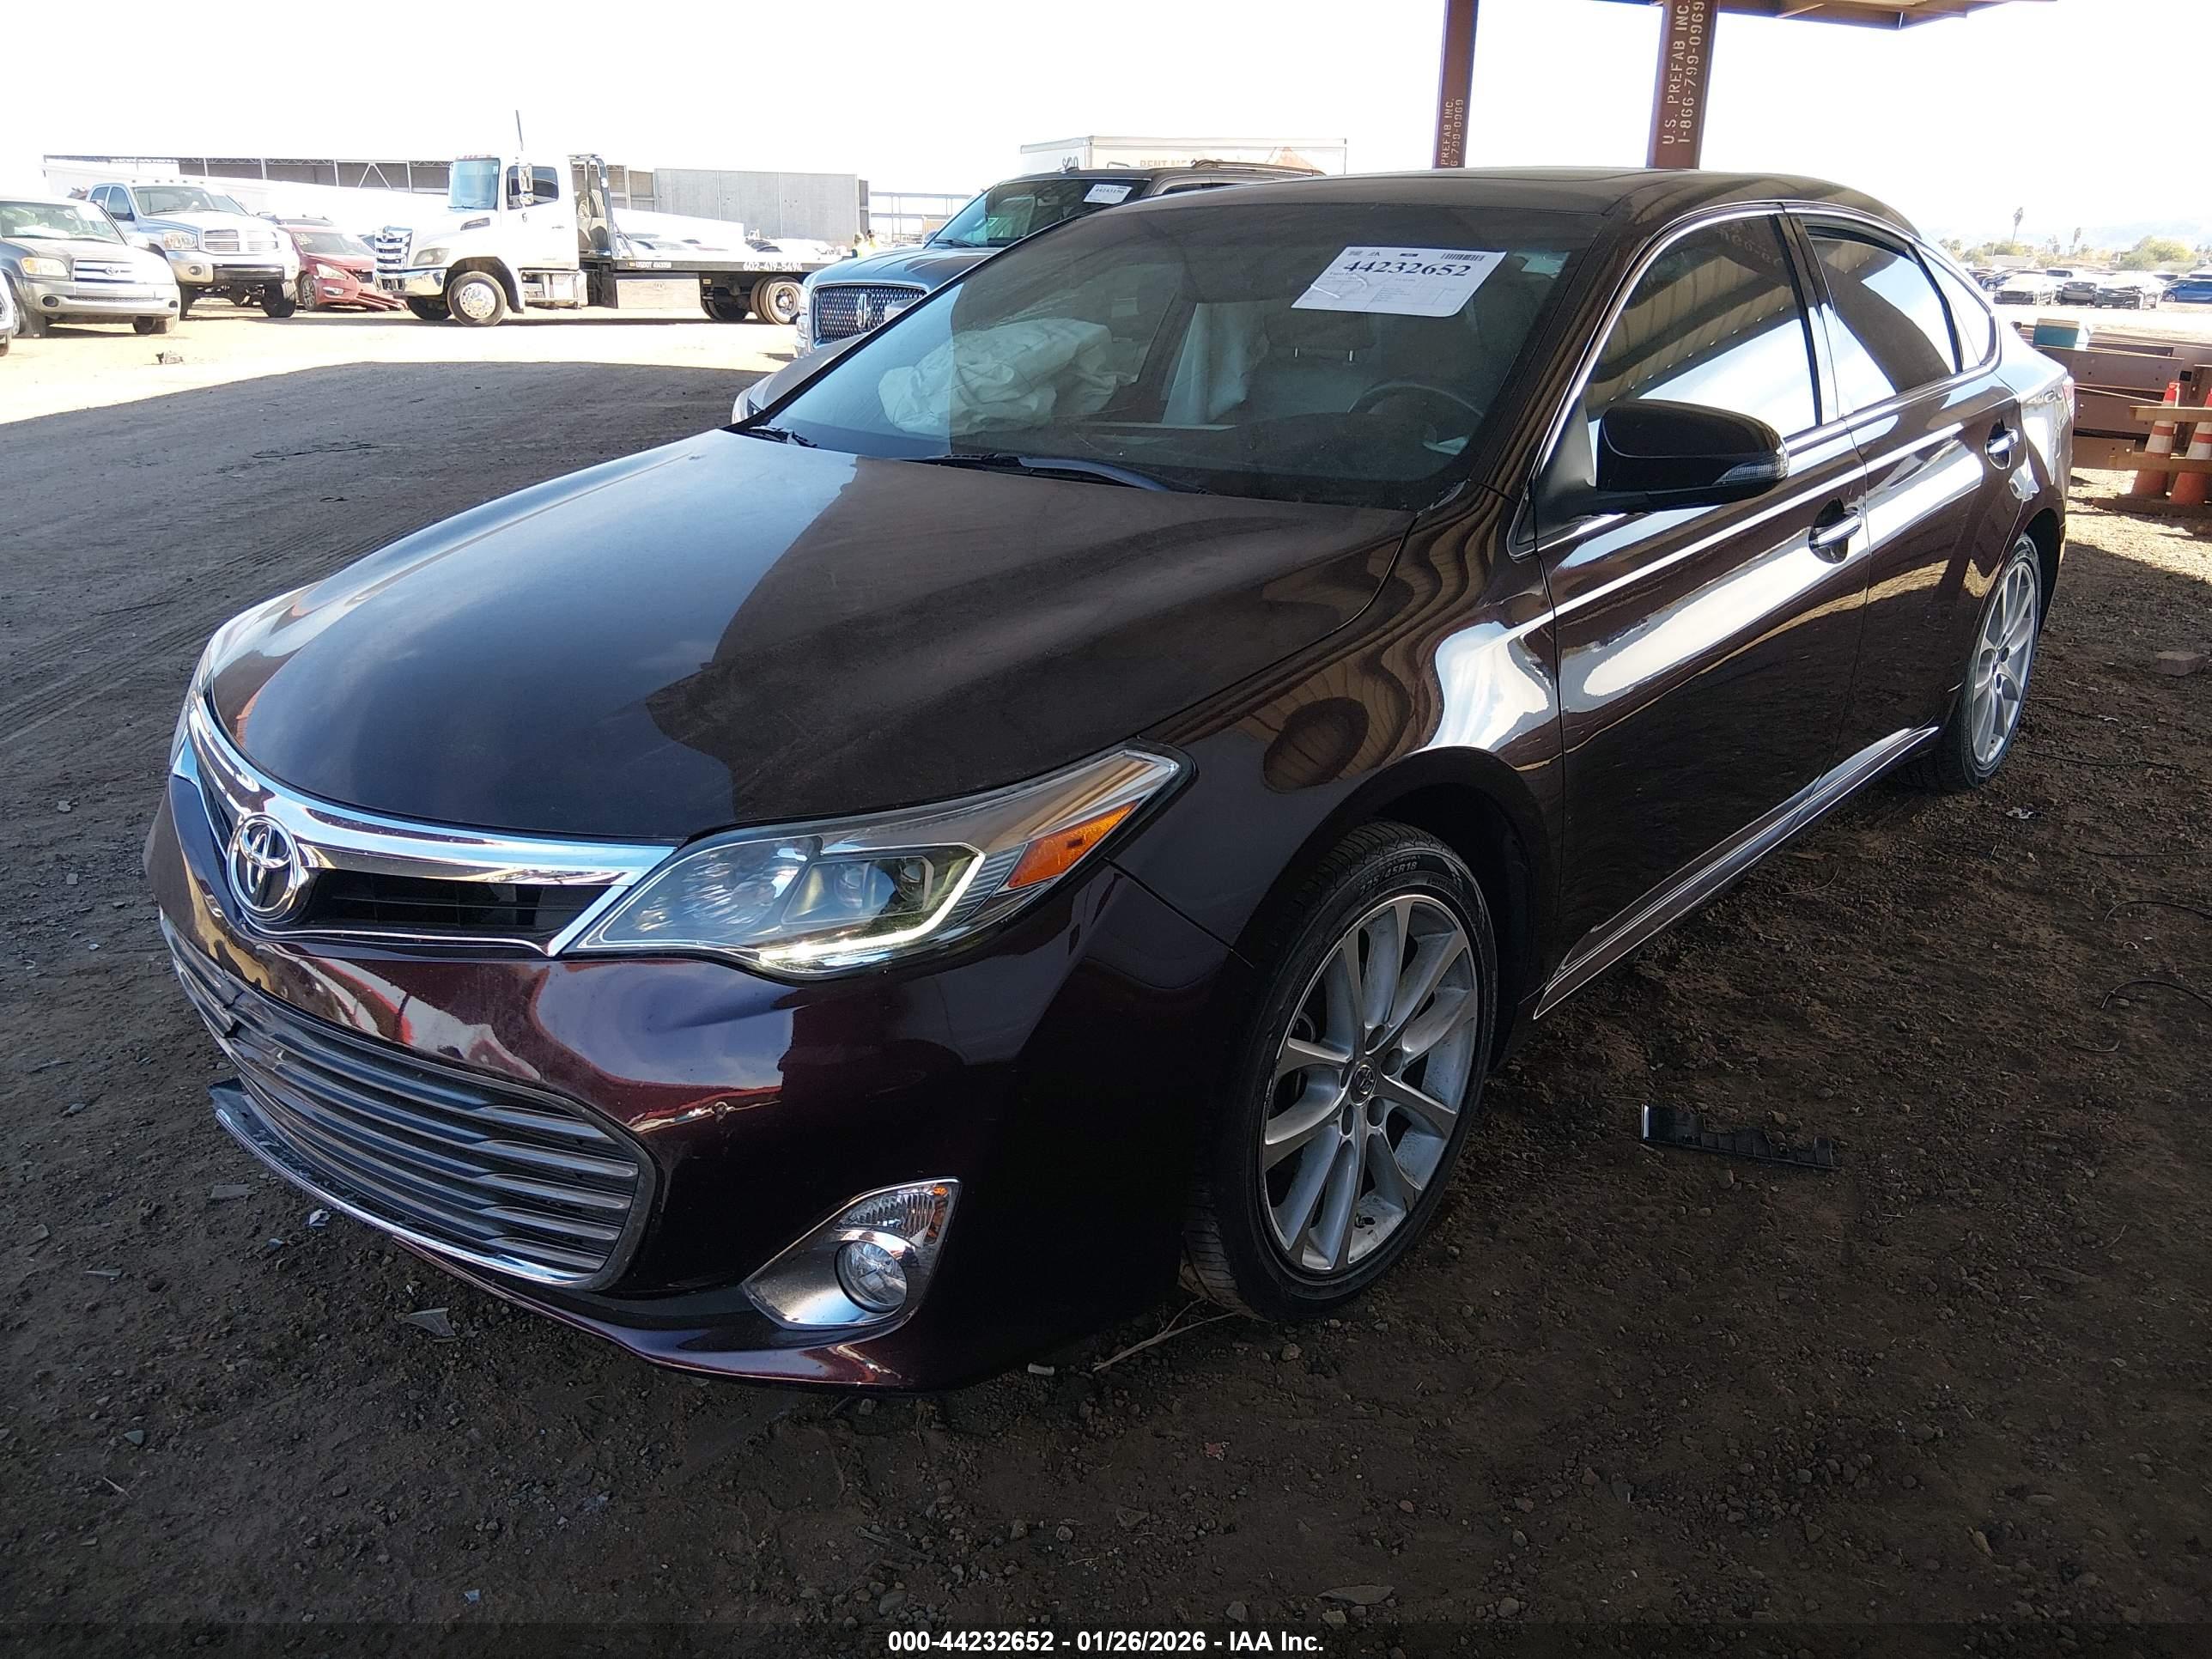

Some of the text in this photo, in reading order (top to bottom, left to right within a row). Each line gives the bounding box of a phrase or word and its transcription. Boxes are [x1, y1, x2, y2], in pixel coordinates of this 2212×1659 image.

[1662, 0, 1691, 144] U.S. PREFAB INC.
[1677, 1, 1705, 143] 1-866-799-0969
[1440, 97, 1455, 166] PREFAB INC.
[1343, 260, 1472, 276] 44232652
[1359, 861, 1418, 896] 225/45R18
